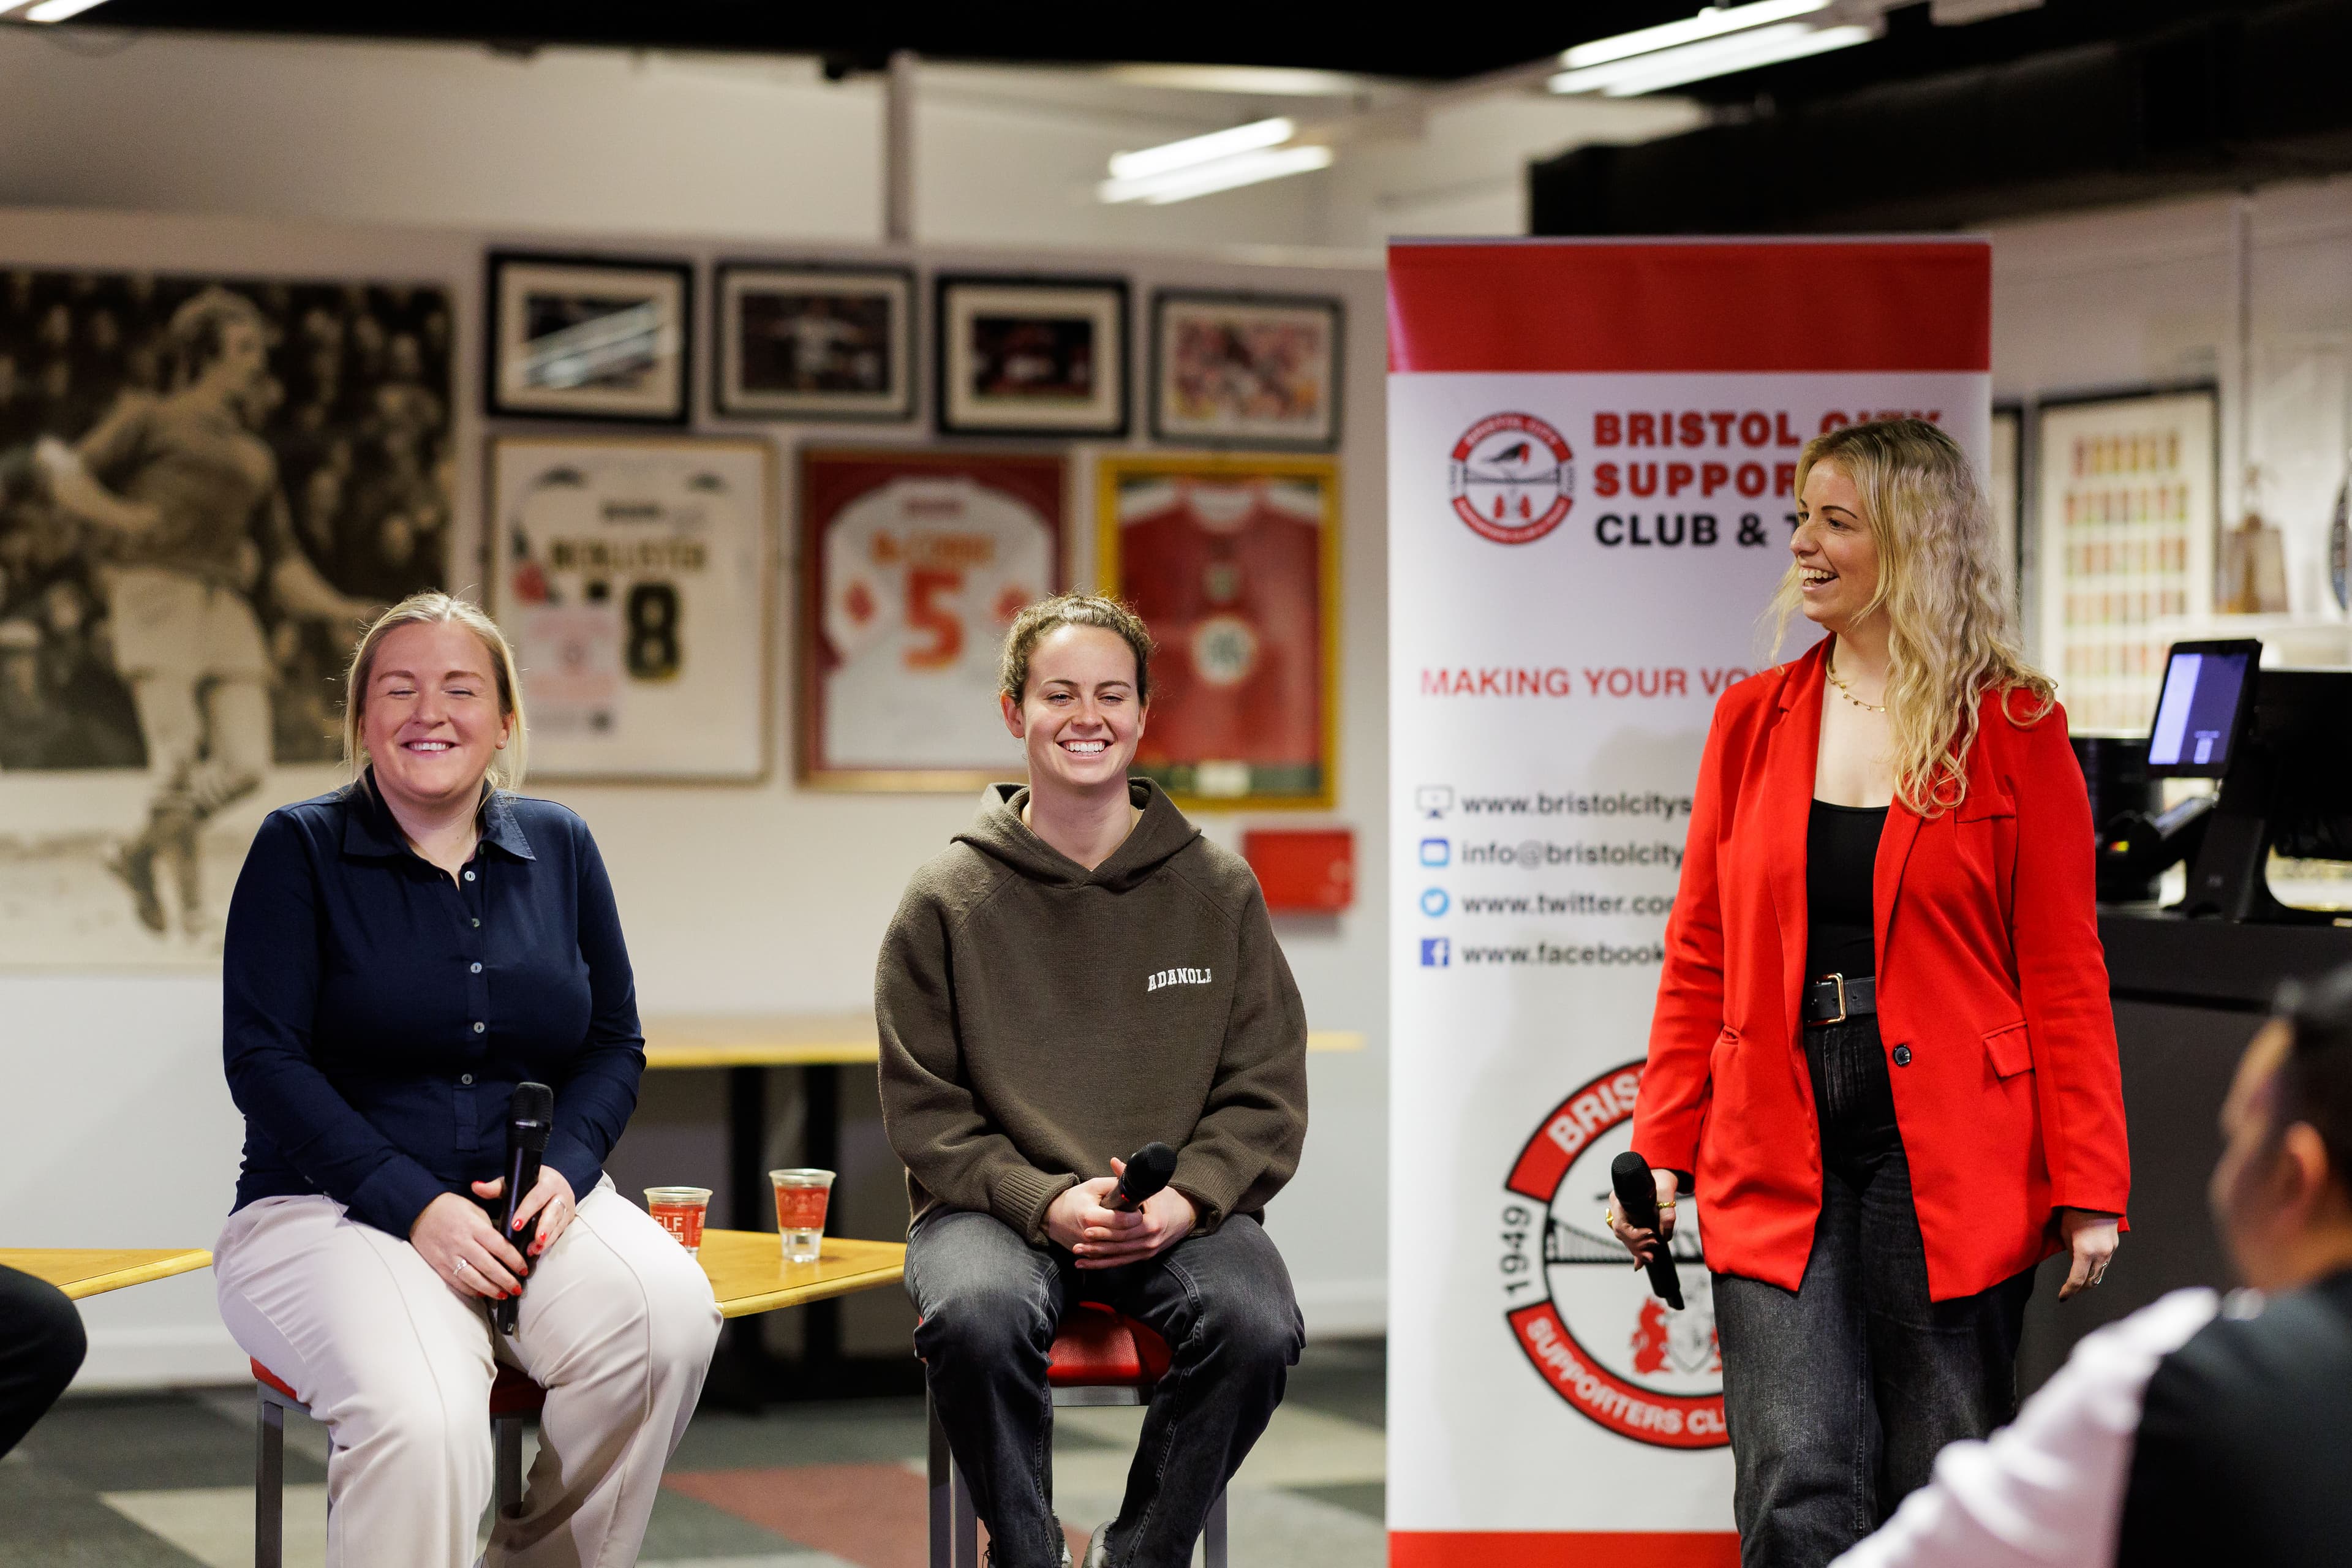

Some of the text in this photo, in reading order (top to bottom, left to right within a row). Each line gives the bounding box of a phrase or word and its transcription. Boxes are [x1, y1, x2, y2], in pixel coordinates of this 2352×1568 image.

[1594, 412, 1801, 447] BRISTOL
[1596, 513, 1717, 546] CLUB
[1737, 513, 1766, 546] &
[626, 581, 684, 684] 8
[902, 567, 966, 673] 5
[1422, 667, 1570, 696] MAKING
[1583, 667, 1688, 696] YOUR
[1548, 1069, 1645, 1154] BRIS
[1500, 1207, 1531, 1294] 1949
[1526, 1317, 1683, 1434] SUPPORTERS
